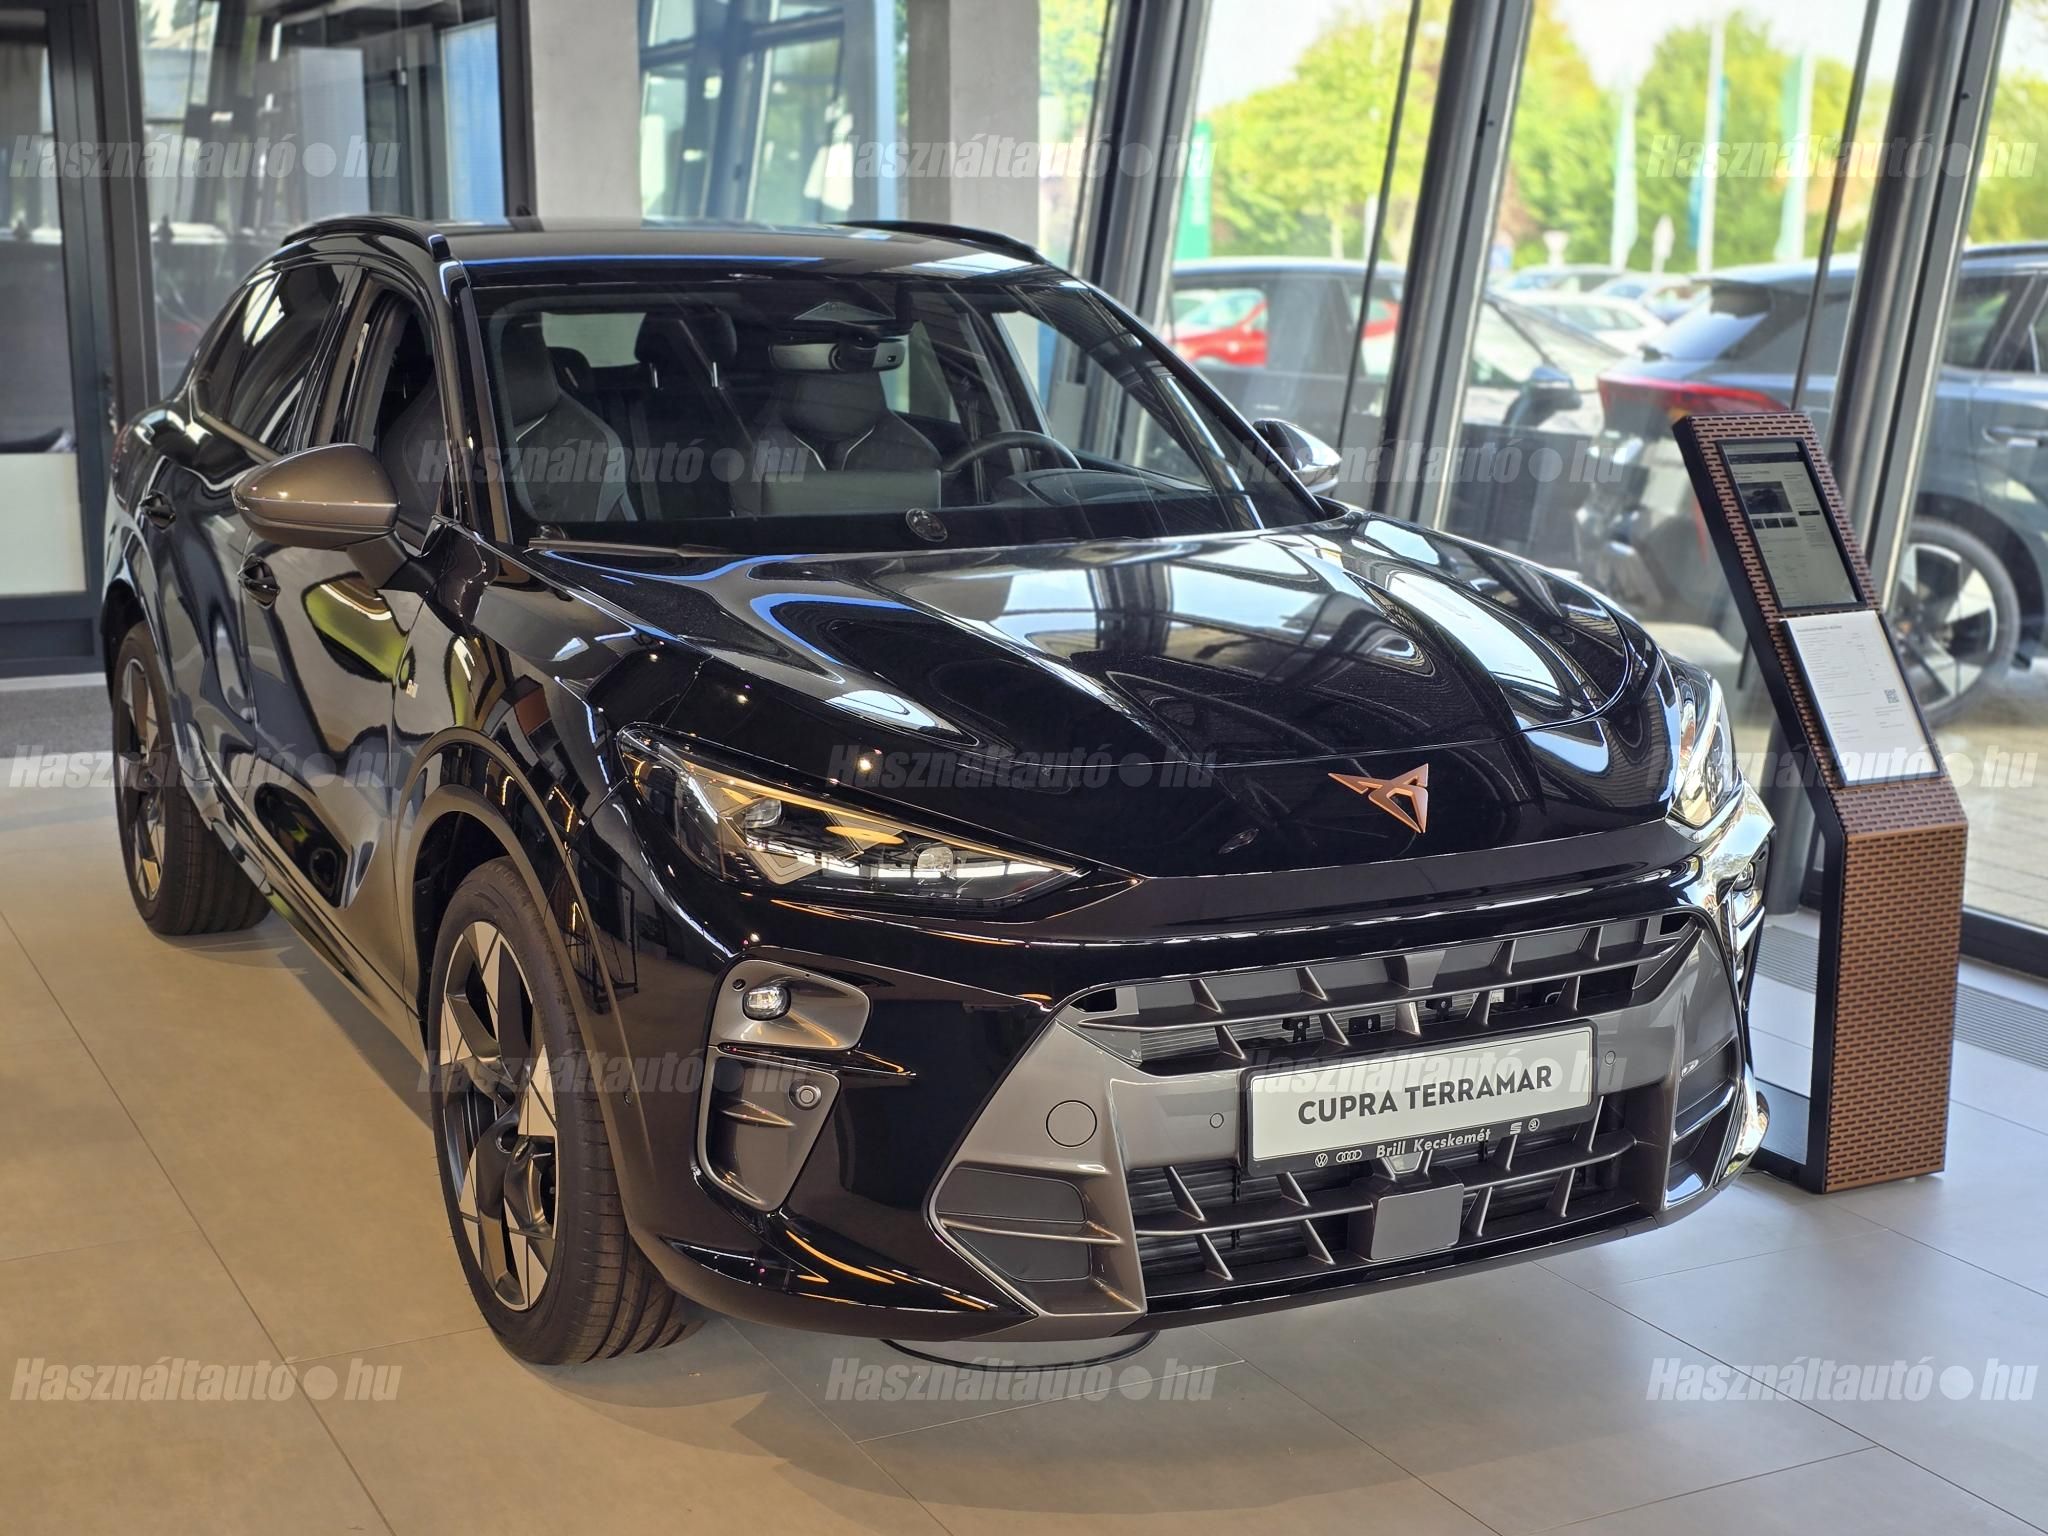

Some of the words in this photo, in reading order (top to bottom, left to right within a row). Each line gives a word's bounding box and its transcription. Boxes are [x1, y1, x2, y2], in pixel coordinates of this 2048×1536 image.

[1298, 1089, 1398, 1125] CUPRA
[1404, 1065, 1552, 1110] TERRAMAR
[1376, 1141, 1406, 1159] Brill
[1413, 1128, 1491, 1152] Kecskemét
